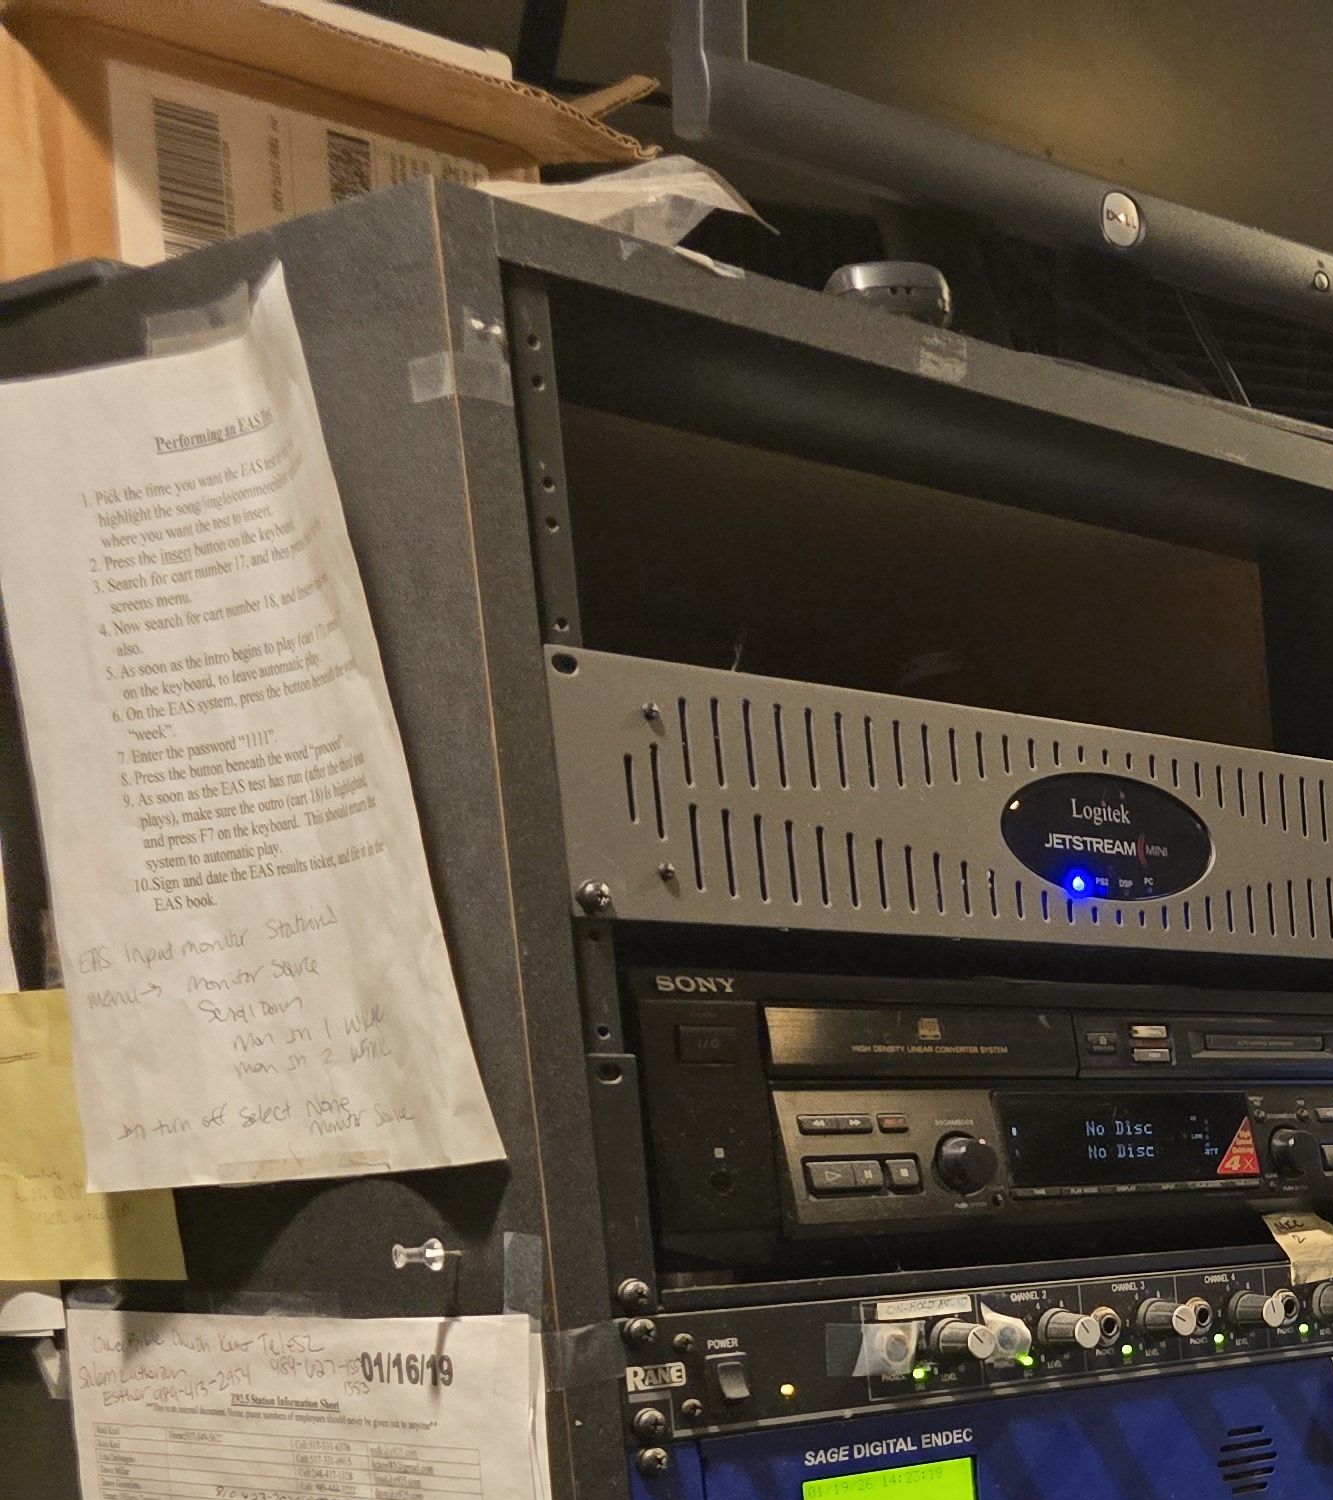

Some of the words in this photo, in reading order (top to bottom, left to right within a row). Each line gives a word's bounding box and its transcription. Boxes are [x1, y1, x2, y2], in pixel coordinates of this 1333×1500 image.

[154, 428, 223, 451] Performing
[225, 424, 237, 438] an
[237, 416, 261, 434] EAS
[121, 773, 131, 787] 8.
[135, 770, 165, 785] Press
[168, 766, 186, 781] the
[190, 761, 224, 779] button
[226, 754, 266, 773] beneath
[268, 749, 282, 766] the
[284, 745, 309, 763] word
[1071, 798, 1131, 826] Logitek
[1045, 832, 1137, 857] JETSTREAM
[1145, 844, 1168, 858] MINI
[183, 872, 203, 887] and
[207, 869, 228, 885] date
[231, 866, 248, 882] the
[250, 862, 275, 879] EAS
[276, 856, 309, 876] results
[154, 896, 182, 911] EAS
[186, 892, 218, 909] book.
[656, 974, 735, 993] SONY
[1086, 1120, 1106, 1136] No
[1115, 1120, 1153, 1135] Disc
[1088, 1144, 1107, 1160] No
[1117, 1143, 1154, 1159] Disc
[1111, 1282, 1138, 1293] CHANNEL
[1140, 1281, 1145, 1291] 3
[1204, 1274, 1228, 1284] CHANNEL
[1230, 1273, 1235, 1282] 4
[1011, 1291, 1039, 1302] CHANNEL
[1042, 1290, 1047, 1299] 2
[707, 1338, 739, 1349] POWER
[361, 1352, 453, 1386] 01/16/19
[626, 1363, 685, 1392] RANE
[804, 1445, 849, 1466] SAGE
[853, 1436, 917, 1460] DIGITAL
[921, 1428, 973, 1451] ENDEC
[807, 1477, 873, 1499] 01/19/26
[882, 1467, 943, 1488] 14:23:19
